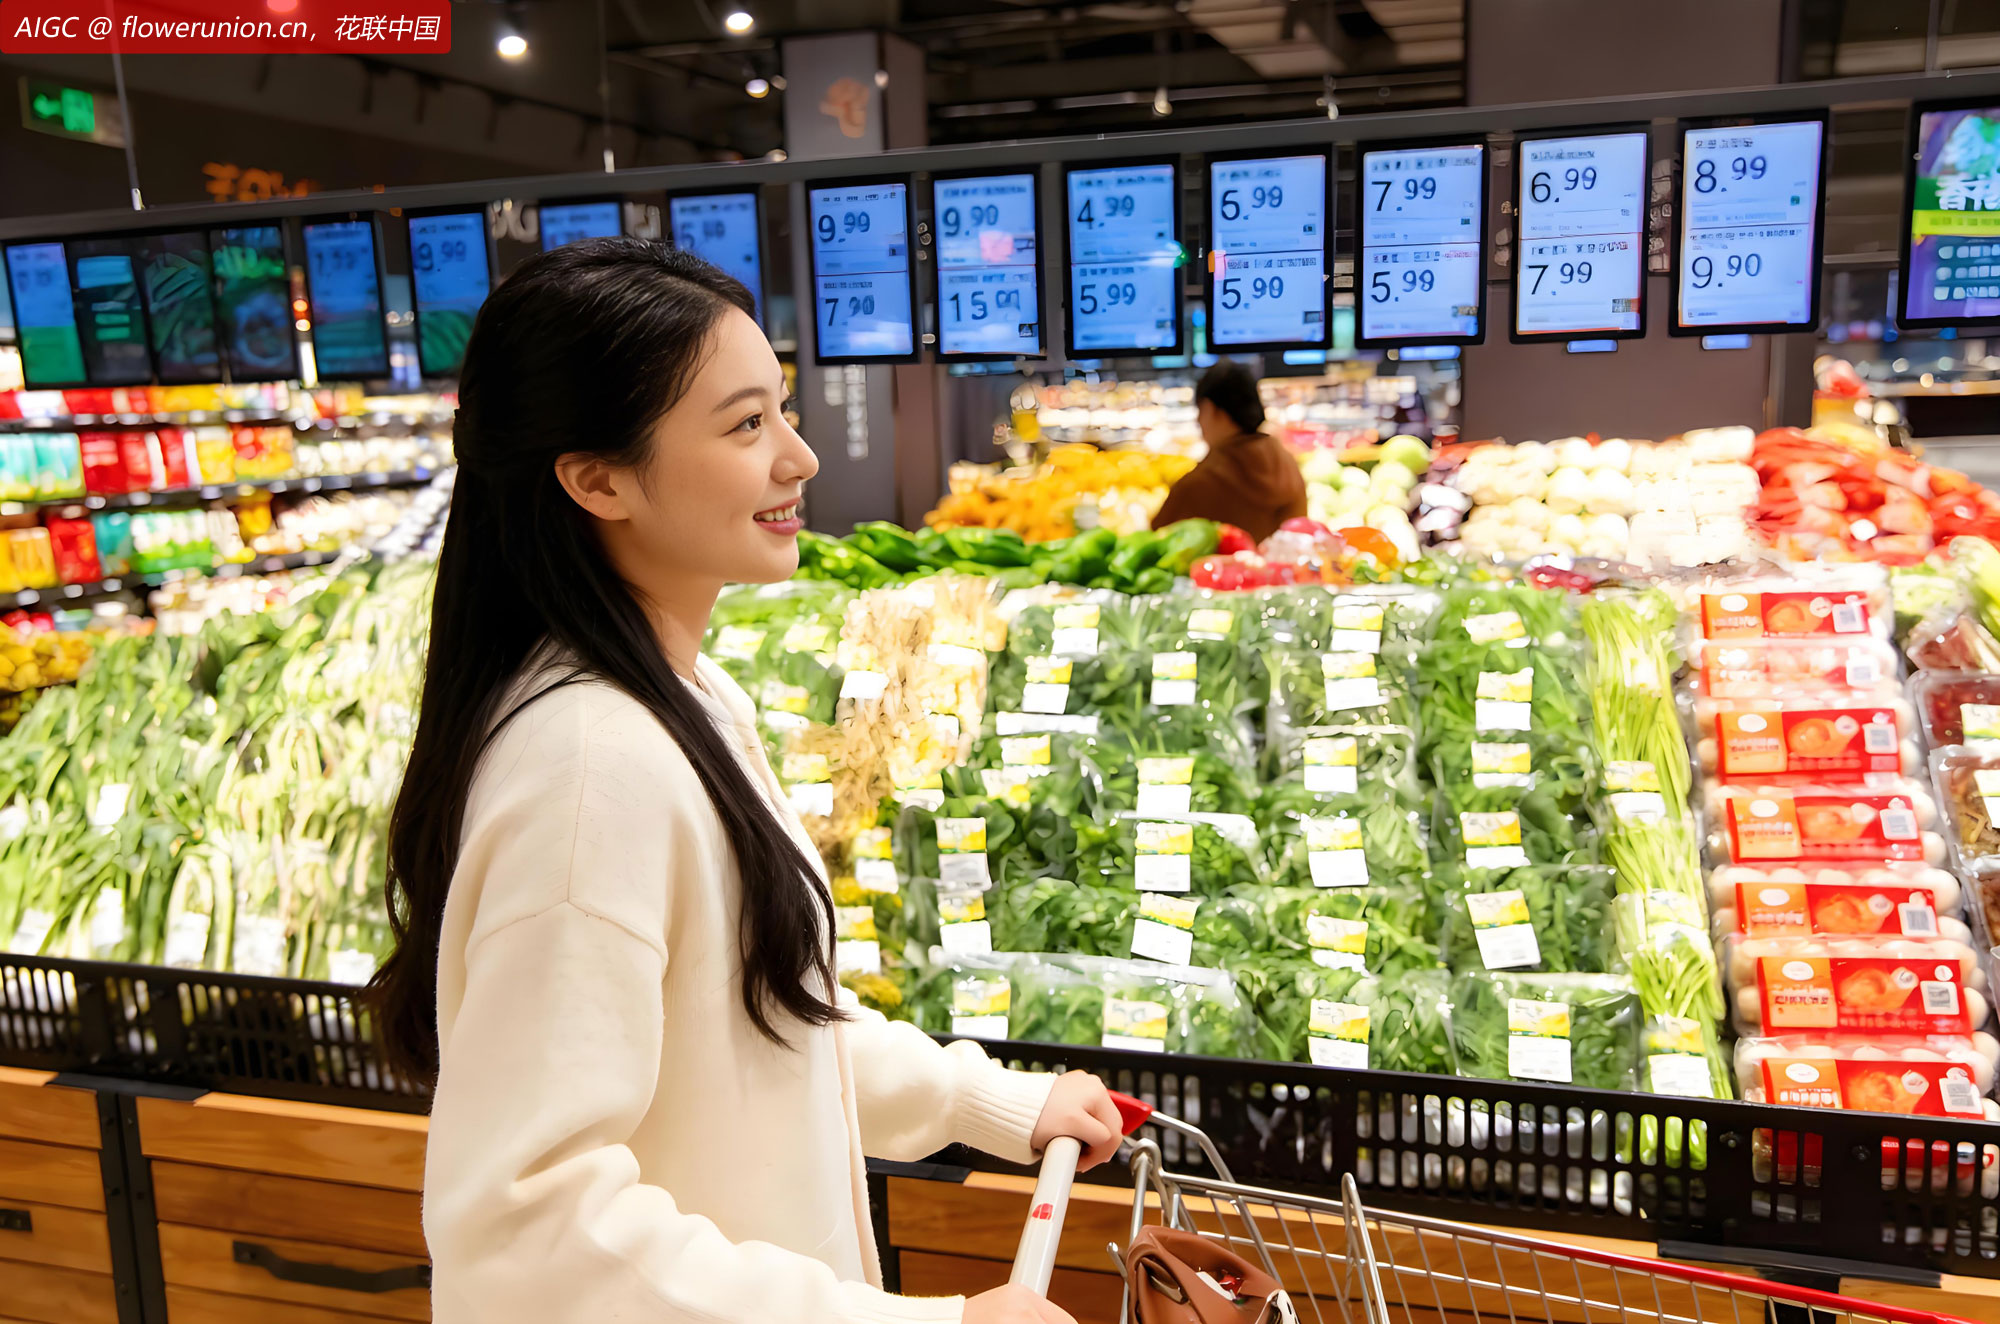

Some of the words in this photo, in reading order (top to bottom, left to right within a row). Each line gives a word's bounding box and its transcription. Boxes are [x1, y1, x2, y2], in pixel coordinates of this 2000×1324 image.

[1531, 166, 1597, 203] 6.99
[1694, 156, 1767, 193] 8.99
[1221, 186, 1283, 221] 6.99
[1371, 177, 1437, 212] 7.99
[818, 211, 871, 243] 9.99
[943, 204, 999, 237] 9.90
[1370, 269, 1435, 303] 5.99
[1527, 261, 1593, 296] 7.99
[1691, 253, 1762, 289] 9.90
[1080, 283, 1137, 315] 5.99
